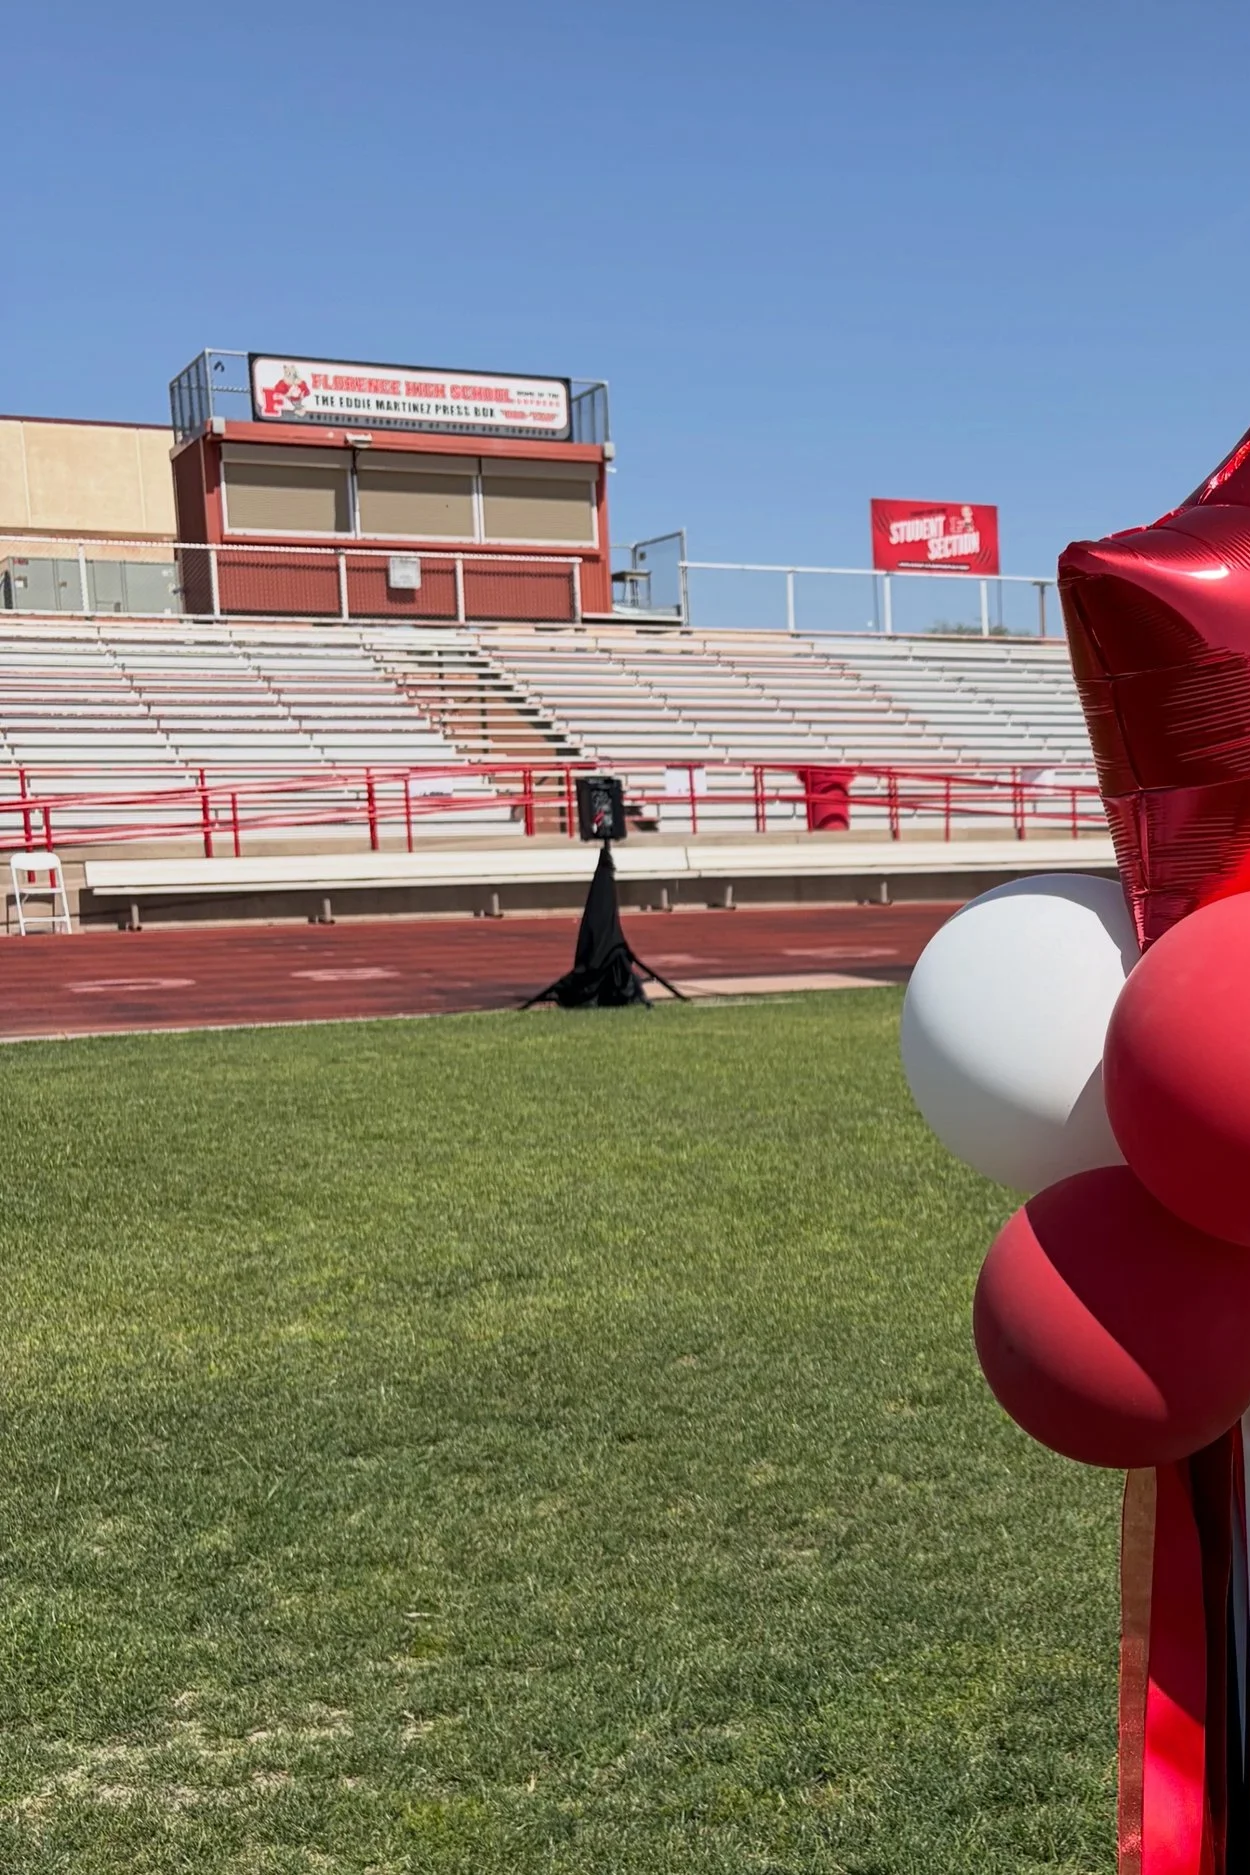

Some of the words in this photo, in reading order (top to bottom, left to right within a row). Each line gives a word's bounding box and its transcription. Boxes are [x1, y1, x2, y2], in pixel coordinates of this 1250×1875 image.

[263, 386, 284, 414] F
[311, 372, 401, 396] FLORENCE
[405, 380, 446, 399] HIGH
[450, 384, 513, 403] SCHOOL
[315, 395, 334, 407] THE
[340, 397, 371, 410] EDDIE
[376, 399, 431, 415] MARTINEZ
[435, 404, 470, 417] PRESS
[474, 407, 496, 418] BOX
[889, 515, 946, 545] STUDENT
[927, 531, 980, 561] SECTION
